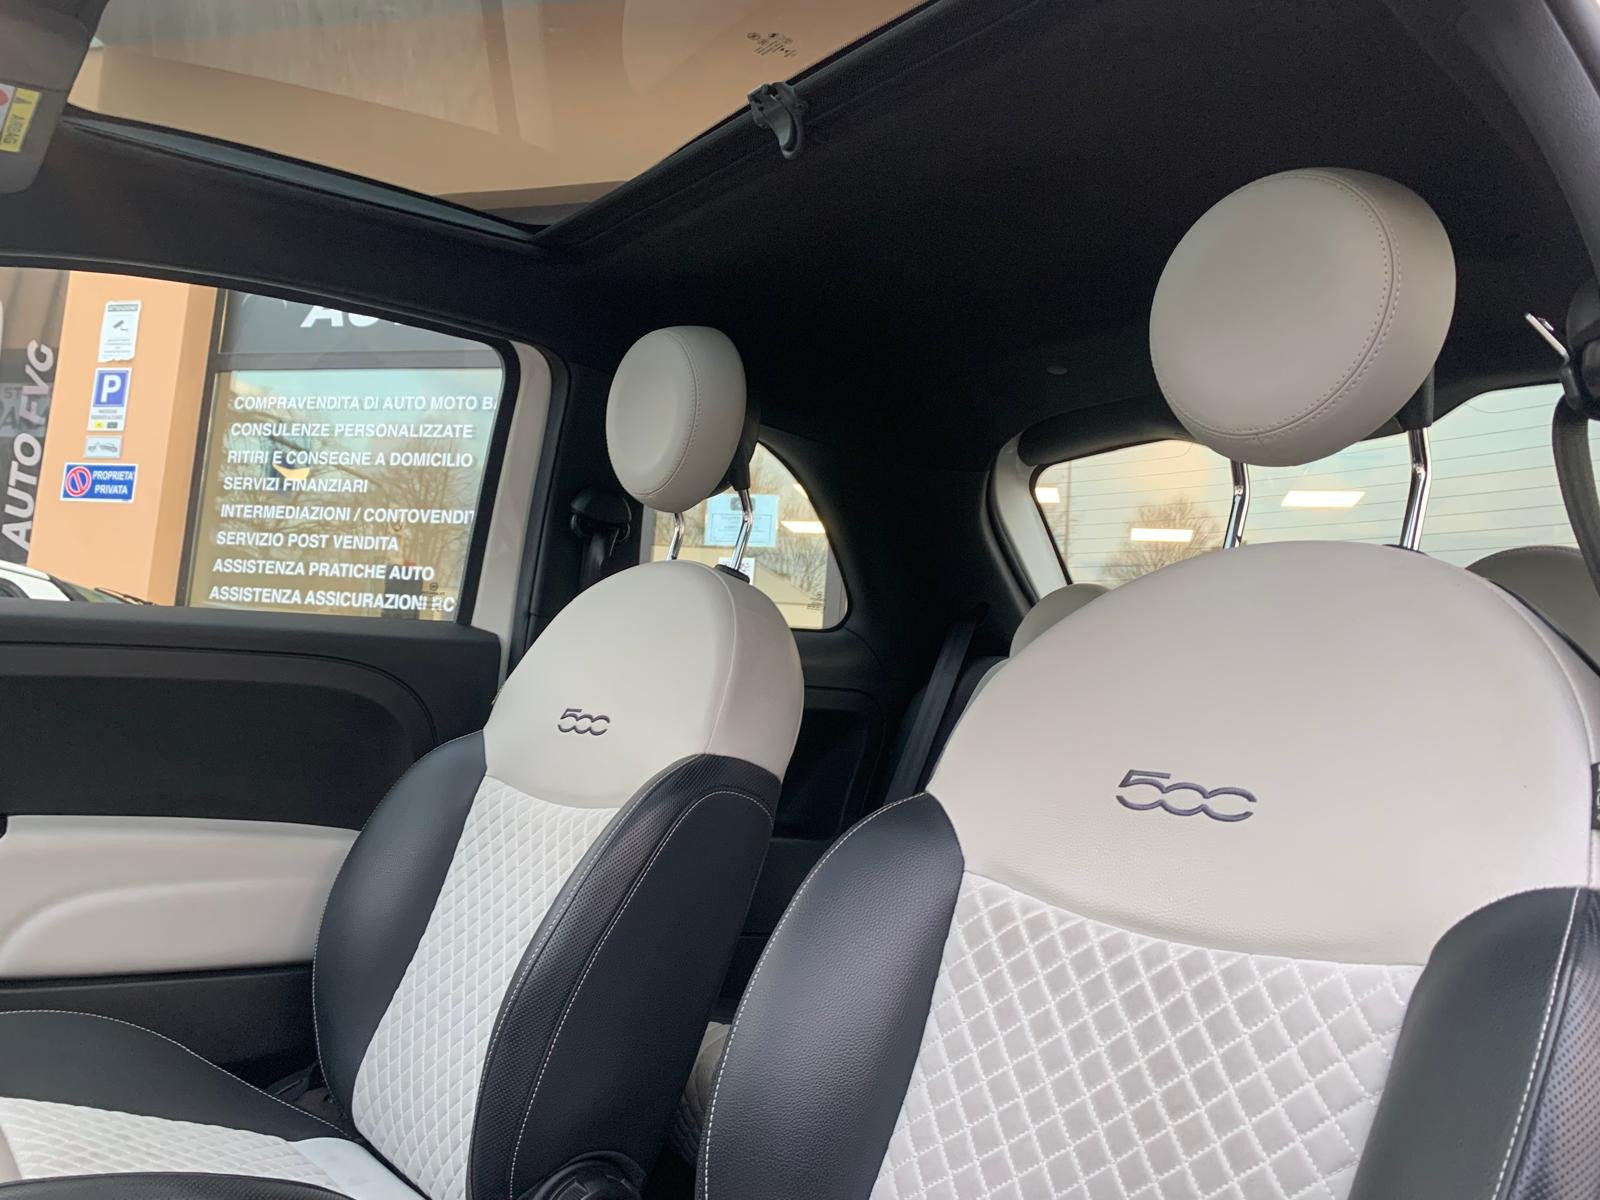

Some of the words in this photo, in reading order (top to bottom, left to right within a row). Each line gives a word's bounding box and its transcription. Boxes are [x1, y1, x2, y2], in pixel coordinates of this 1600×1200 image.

[18, 339, 54, 427] FVG
[100, 374, 122, 403] P
[234, 396, 360, 410] COMPRAVENDITA
[363, 396, 380, 410] DI
[382, 396, 426, 410] AUTO
[430, 396, 478, 411] MOTO
[230, 422, 331, 437] CONSULENZE
[334, 423, 474, 438] PERSONALIZZATE
[227, 450, 269, 464] RITIRI
[272, 450, 283, 464] E
[286, 451, 372, 466] CONSEGNE
[374, 452, 386, 466] A
[389, 452, 473, 467] DOMICILIO
[1, 432, 42, 551] AUTO
[94, 484, 128, 494] PRIVATA
[223, 477, 280, 491] SERVIZI
[283, 478, 369, 493] FINANZIARI
[220, 504, 351, 521] INTERMEDIAZIONI
[353, 507, 361, 522] /
[216, 531, 284, 547] SERVIZIO
[287, 533, 330, 549] POST
[333, 535, 399, 551] VENDITA
[212, 558, 305, 575] ASSISTENZA
[308, 562, 387, 579] PRATICHE
[389, 565, 435, 581] AUTO
[208, 585, 302, 605] ASSISTENZA
[304, 590, 428, 610] ASSICURAZIONI
[558, 708, 611, 736] 500
[1116, 769, 1257, 822] 500
